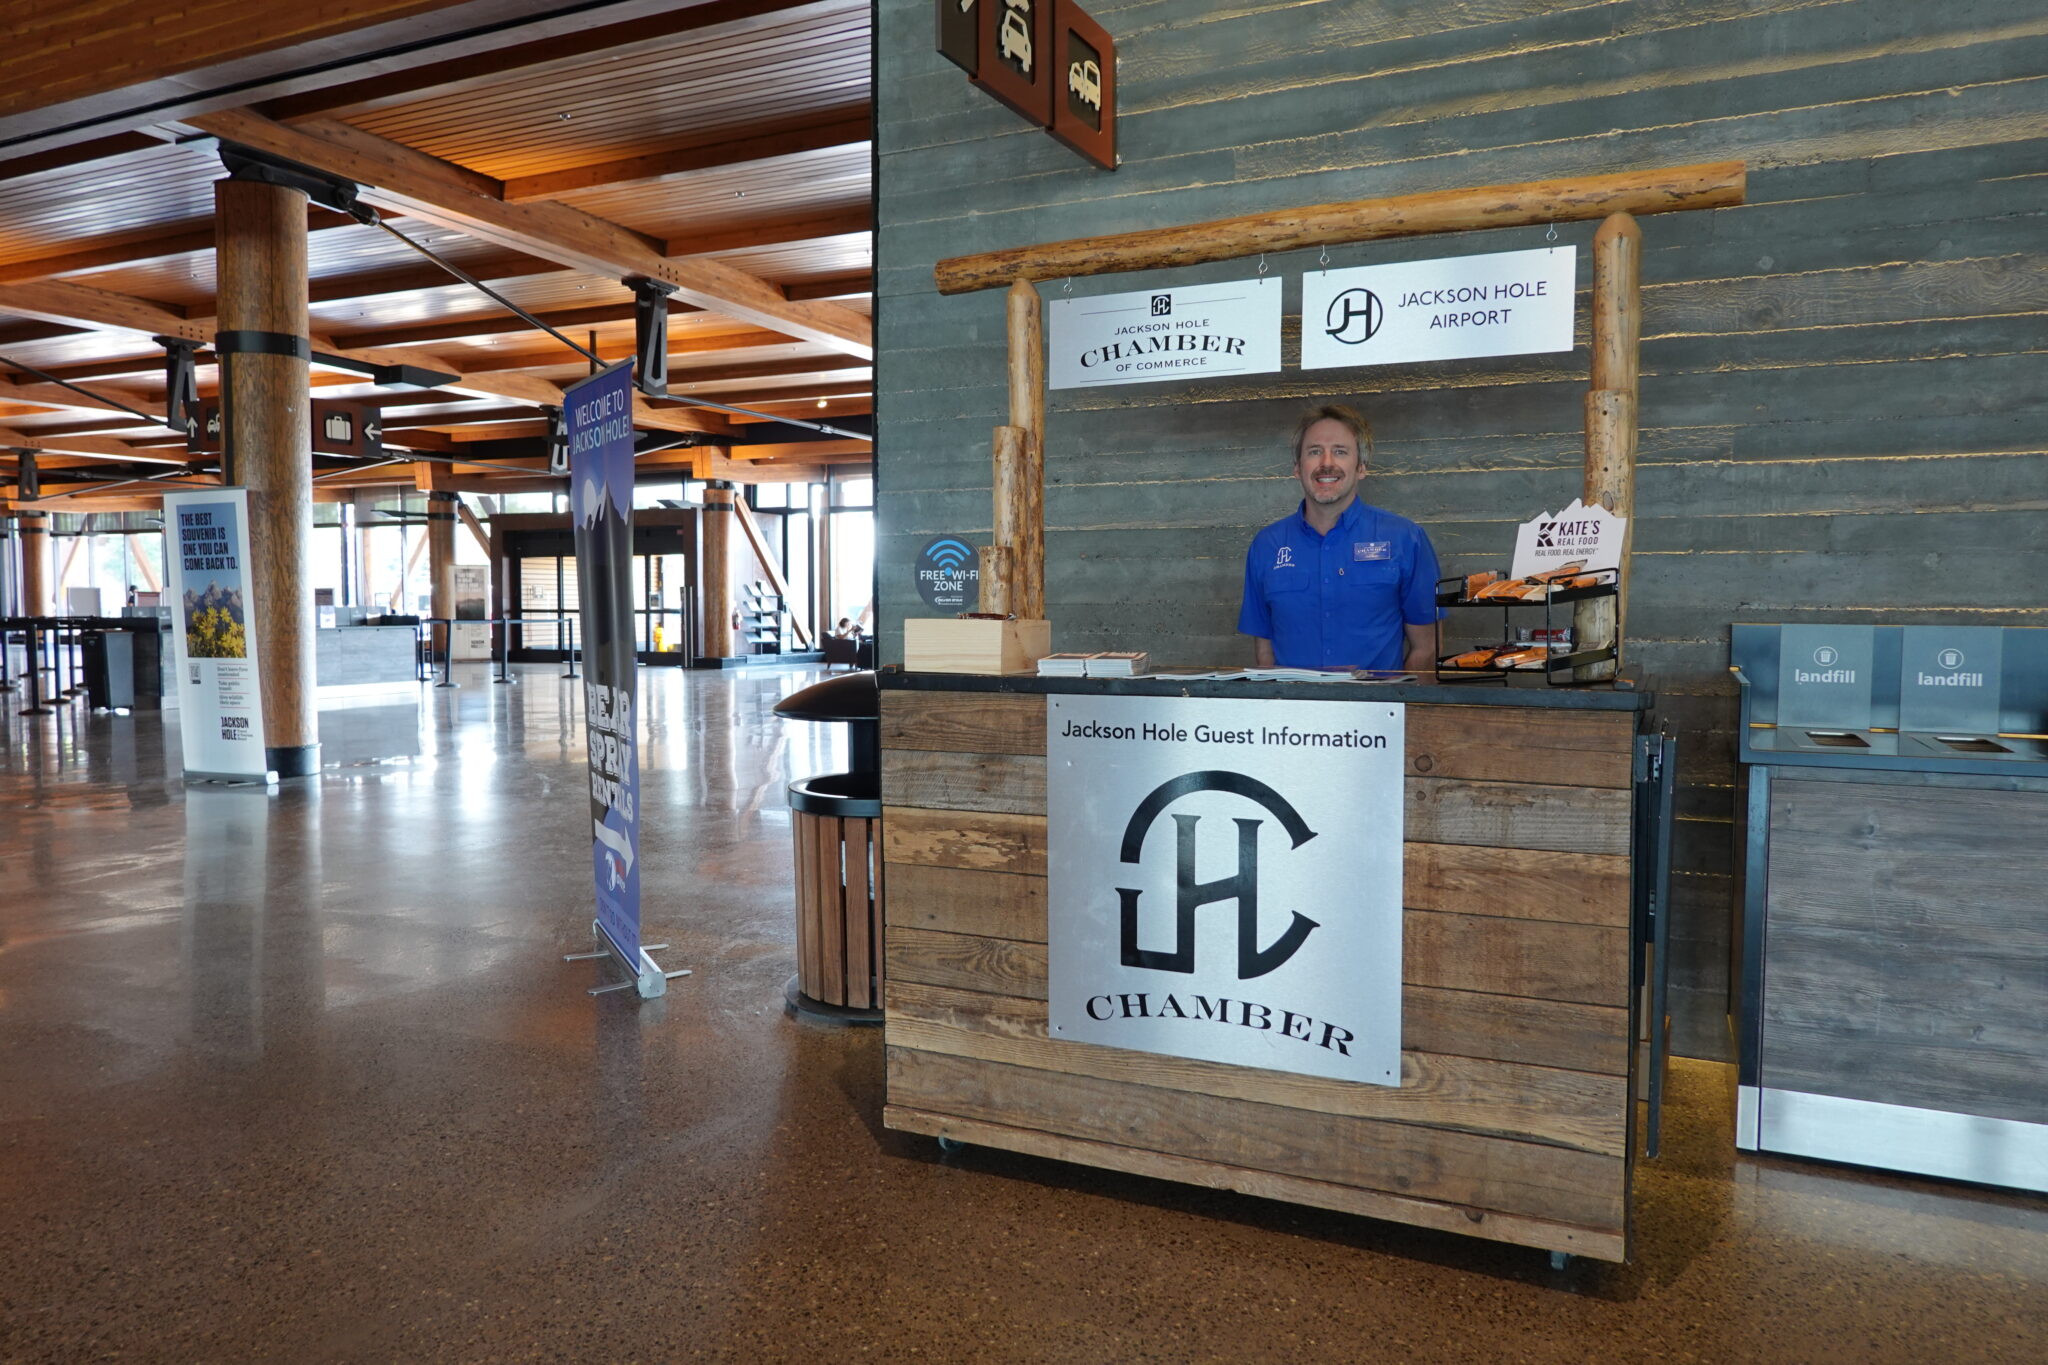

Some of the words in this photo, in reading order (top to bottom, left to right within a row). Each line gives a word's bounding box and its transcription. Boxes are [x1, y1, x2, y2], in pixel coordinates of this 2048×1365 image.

[1398, 286, 1488, 308] JACKSON
[1494, 281, 1548, 300] HOLE
[1430, 309, 1512, 329] AIRPORT
[1114, 322, 1170, 336] JACKSON
[1175, 318, 1210, 330] HOLE
[1080, 334, 1246, 368] CHAMBER
[1115, 363, 1132, 372] OF
[1136, 356, 1207, 371] COMMERCE
[575, 393, 611, 428] WELCOME
[612, 388, 624, 413] TO
[573, 423, 605, 456] JACKSON
[181, 513, 193, 526] THE
[195, 512, 212, 526] BEST
[182, 527, 217, 541] SOUVENIR
[218, 526, 226, 540] IS
[1558, 520, 1600, 537] KATE'S
[1557, 537, 1575, 546] REAL
[1578, 536, 1599, 545] FOOD
[183, 543, 197, 556] ONE
[198, 542, 213, 555] YOU
[213, 542, 229, 555] CAN
[1535, 549, 1546, 557] REAL
[1563, 548, 1575, 556] REAL
[184, 557, 204, 571] COME
[205, 557, 225, 570] BACK
[920, 570, 946, 581] FREE
[952, 570, 979, 581] WI-FI
[933, 581, 964, 591] ZONE
[1795, 669, 1856, 684] landfill
[1918, 672, 1983, 687] landfill
[587, 681, 632, 741] BEAR
[221, 716, 249, 729] JACKSON
[221, 729, 237, 741] HOLE
[1061, 720, 1136, 741] Jackson
[1143, 723, 1187, 742] Hole
[1194, 725, 1255, 745] Guest
[1262, 727, 1387, 749] Information
[1086, 992, 1355, 1058] CHAMBER
